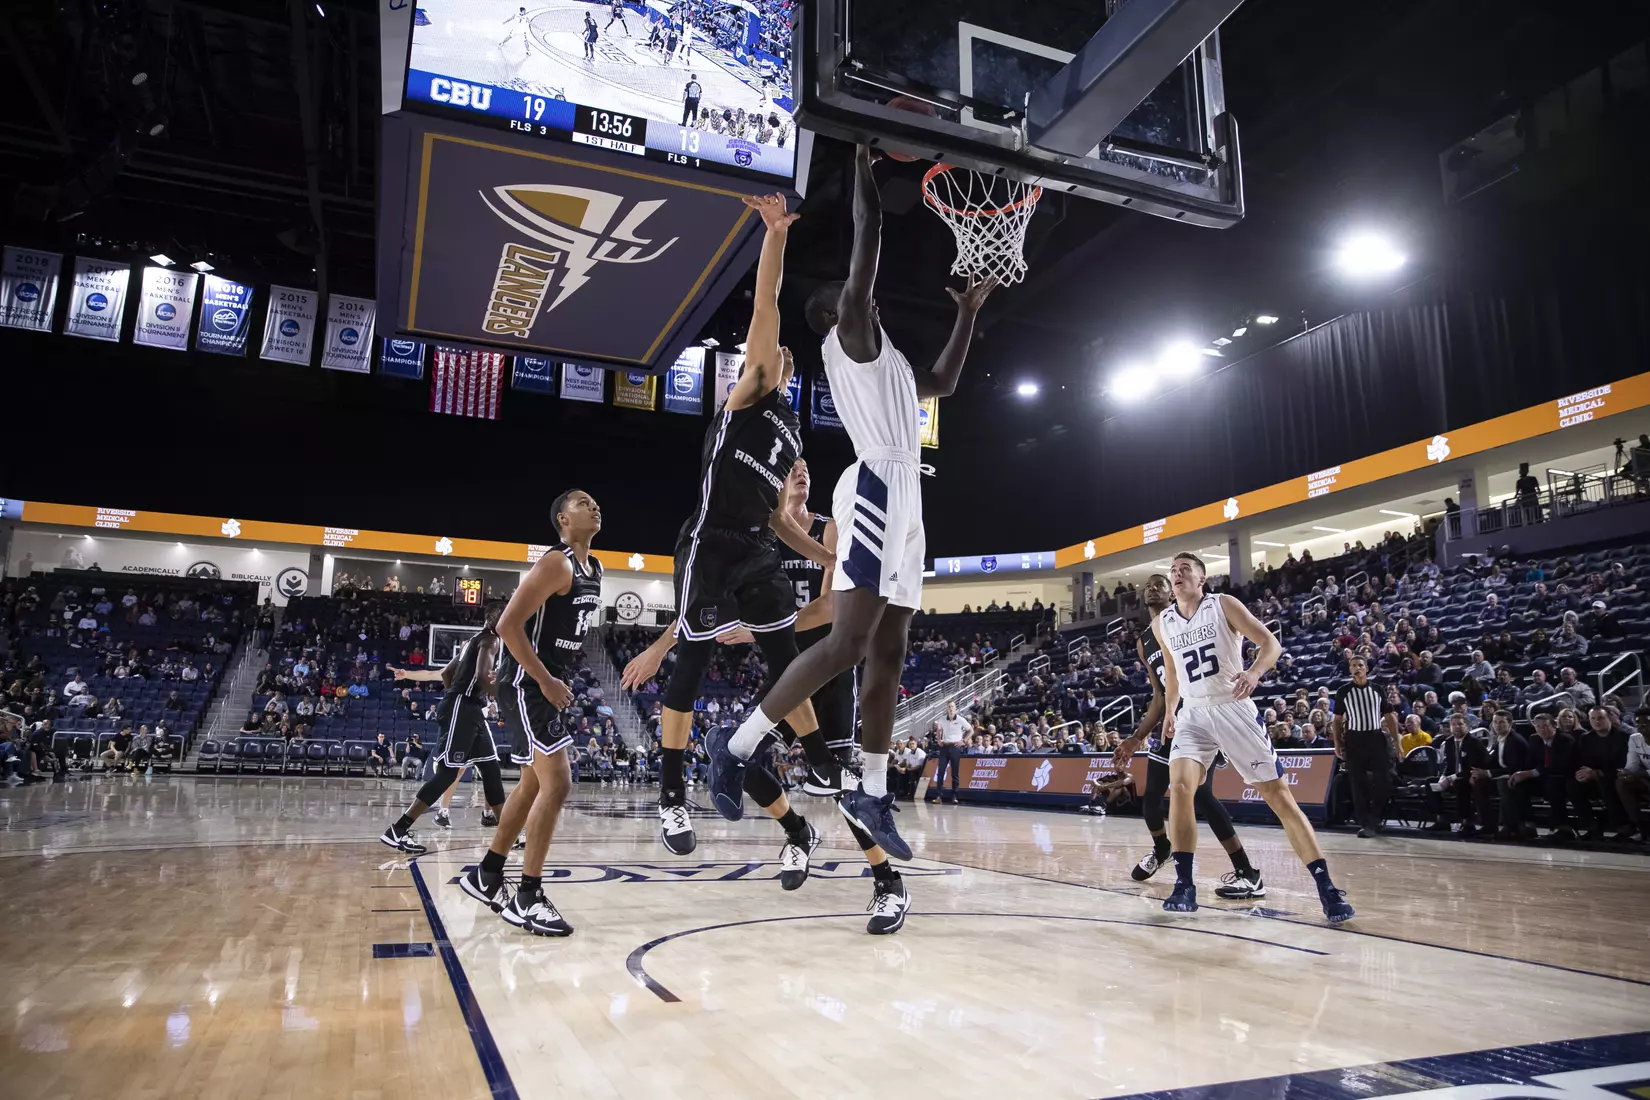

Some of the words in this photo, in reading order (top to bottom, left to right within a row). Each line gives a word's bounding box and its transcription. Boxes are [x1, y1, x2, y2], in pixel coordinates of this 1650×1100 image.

[430, 77, 492, 111] CBU
[523, 95, 546, 121] 19
[510, 119, 532, 132] FLS
[540, 126, 547, 135] 3
[590, 110, 633, 137] 13:56
[585, 135, 604, 146] 1ST
[610, 139, 636, 153] HALF
[680, 128, 700, 154] 13
[667, 152, 688, 165] FLS
[695, 159, 700, 167] 1
[15, 254, 49, 266] 2018
[86, 264, 117, 277] 2017
[86, 276, 112, 285] MEN'S
[155, 276, 185, 287] 2016
[156, 286, 180, 295] MEN'S
[481, 242, 561, 339] LANCERS
[215, 293, 240, 302] MEN'S
[279, 292, 308, 304] 2015
[87, 300, 107, 308] NCAA
[280, 303, 303, 311] MEN'S
[338, 302, 365, 312] 2014
[76, 312, 105, 322] DIVISION
[270, 308, 314, 320] BASKETBALL
[339, 312, 361, 320] MEN'S
[68, 317, 119, 329] TOURNAMENT
[145, 322, 175, 331] DIVISION
[138, 327, 186, 339] TOURNAMENT
[268, 337, 301, 347] DIVISION
[269, 345, 294, 354] SWEET
[331, 346, 359, 355] DIVISION
[325, 352, 368, 362] TOURNAMENT
[381, 355, 422, 366] CHAMPIONS
[514, 371, 553, 382] CHAMPIONS
[565, 383, 600, 392] CHAMPIONS
[580, 379, 602, 387] REGION
[618, 386, 647, 394] DIVISION
[620, 392, 651, 401] NATIONAL
[664, 393, 701, 403] CHAMPIONS
[1558, 384, 1612, 408] RIVERSIDE
[1559, 398, 1605, 418] MEDICAL
[1560, 411, 1594, 428] CLINIC
[768, 436, 784, 466] 1
[1308, 475, 1337, 490] MEDICAL
[97, 507, 136, 517] RIVERSIDE
[96, 514, 130, 523] MEDICAL
[95, 521, 120, 529] CLINIC
[324, 527, 359, 536] RIVERSIDE
[121, 565, 181, 575] ACADEMICALLY
[948, 559, 960, 573] 13
[231, 573, 272, 582] BIBLICALLY
[460, 580, 480, 590] 13:56
[464, 589, 477, 604] 18
[790, 580, 810, 608] 5
[1170, 622, 1217, 651] LANCERS
[1182, 643, 1220, 683] 25
[976, 758, 1007, 768] RIVERSIDE
[972, 769, 999, 778] MEDICAL
[969, 780, 989, 789] CLINIC
